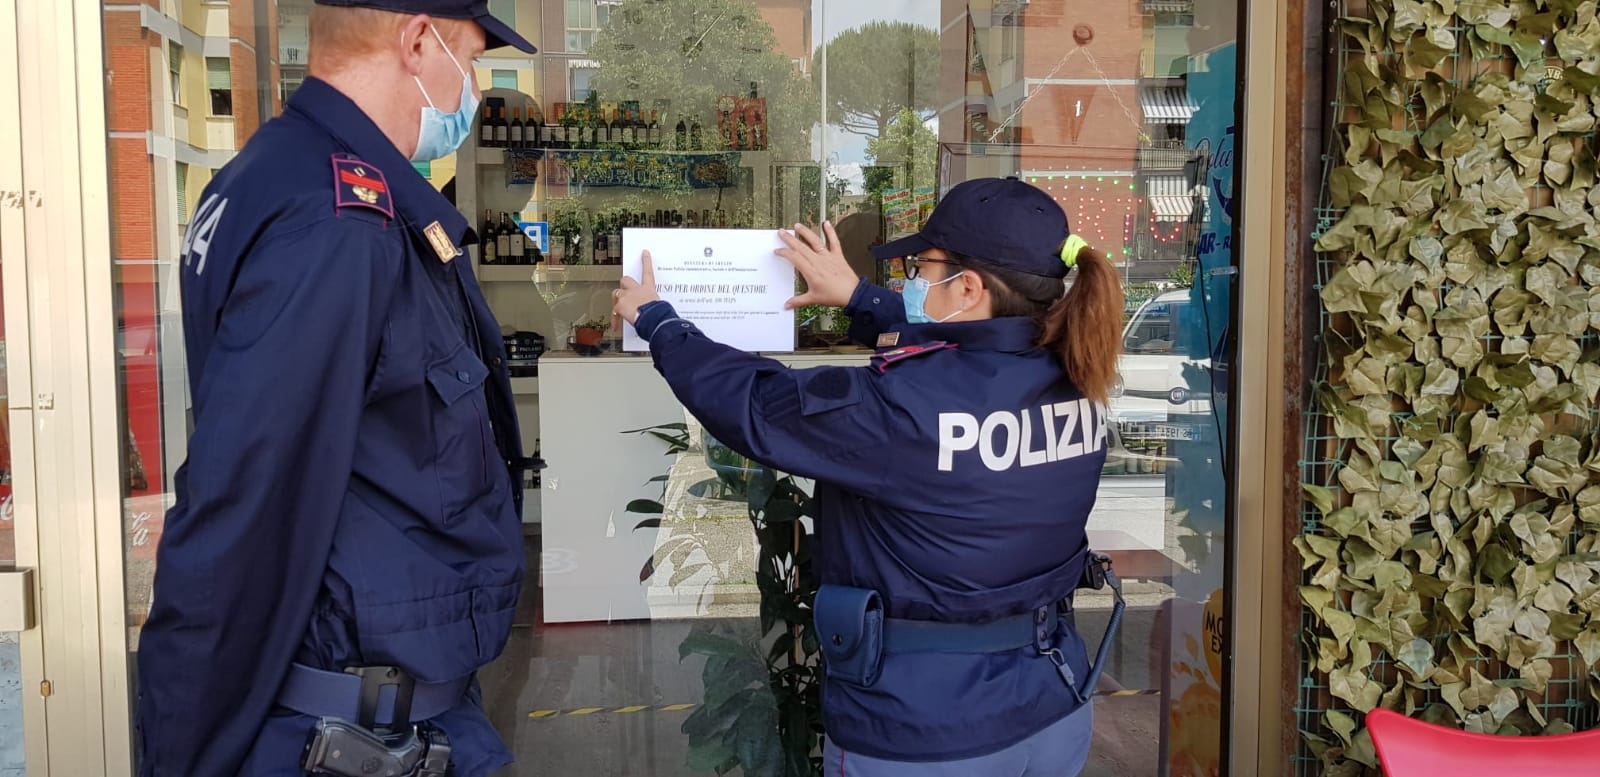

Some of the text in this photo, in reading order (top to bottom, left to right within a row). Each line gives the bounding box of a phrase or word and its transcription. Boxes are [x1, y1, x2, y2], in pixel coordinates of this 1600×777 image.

[1198, 232, 1216, 255] AR
[674, 283, 688, 294] PER
[689, 283, 716, 294] ORDINE
[717, 283, 731, 294] DEL
[732, 283, 768, 295] QUESTORE
[937, 398, 1108, 472] POLIZIA
